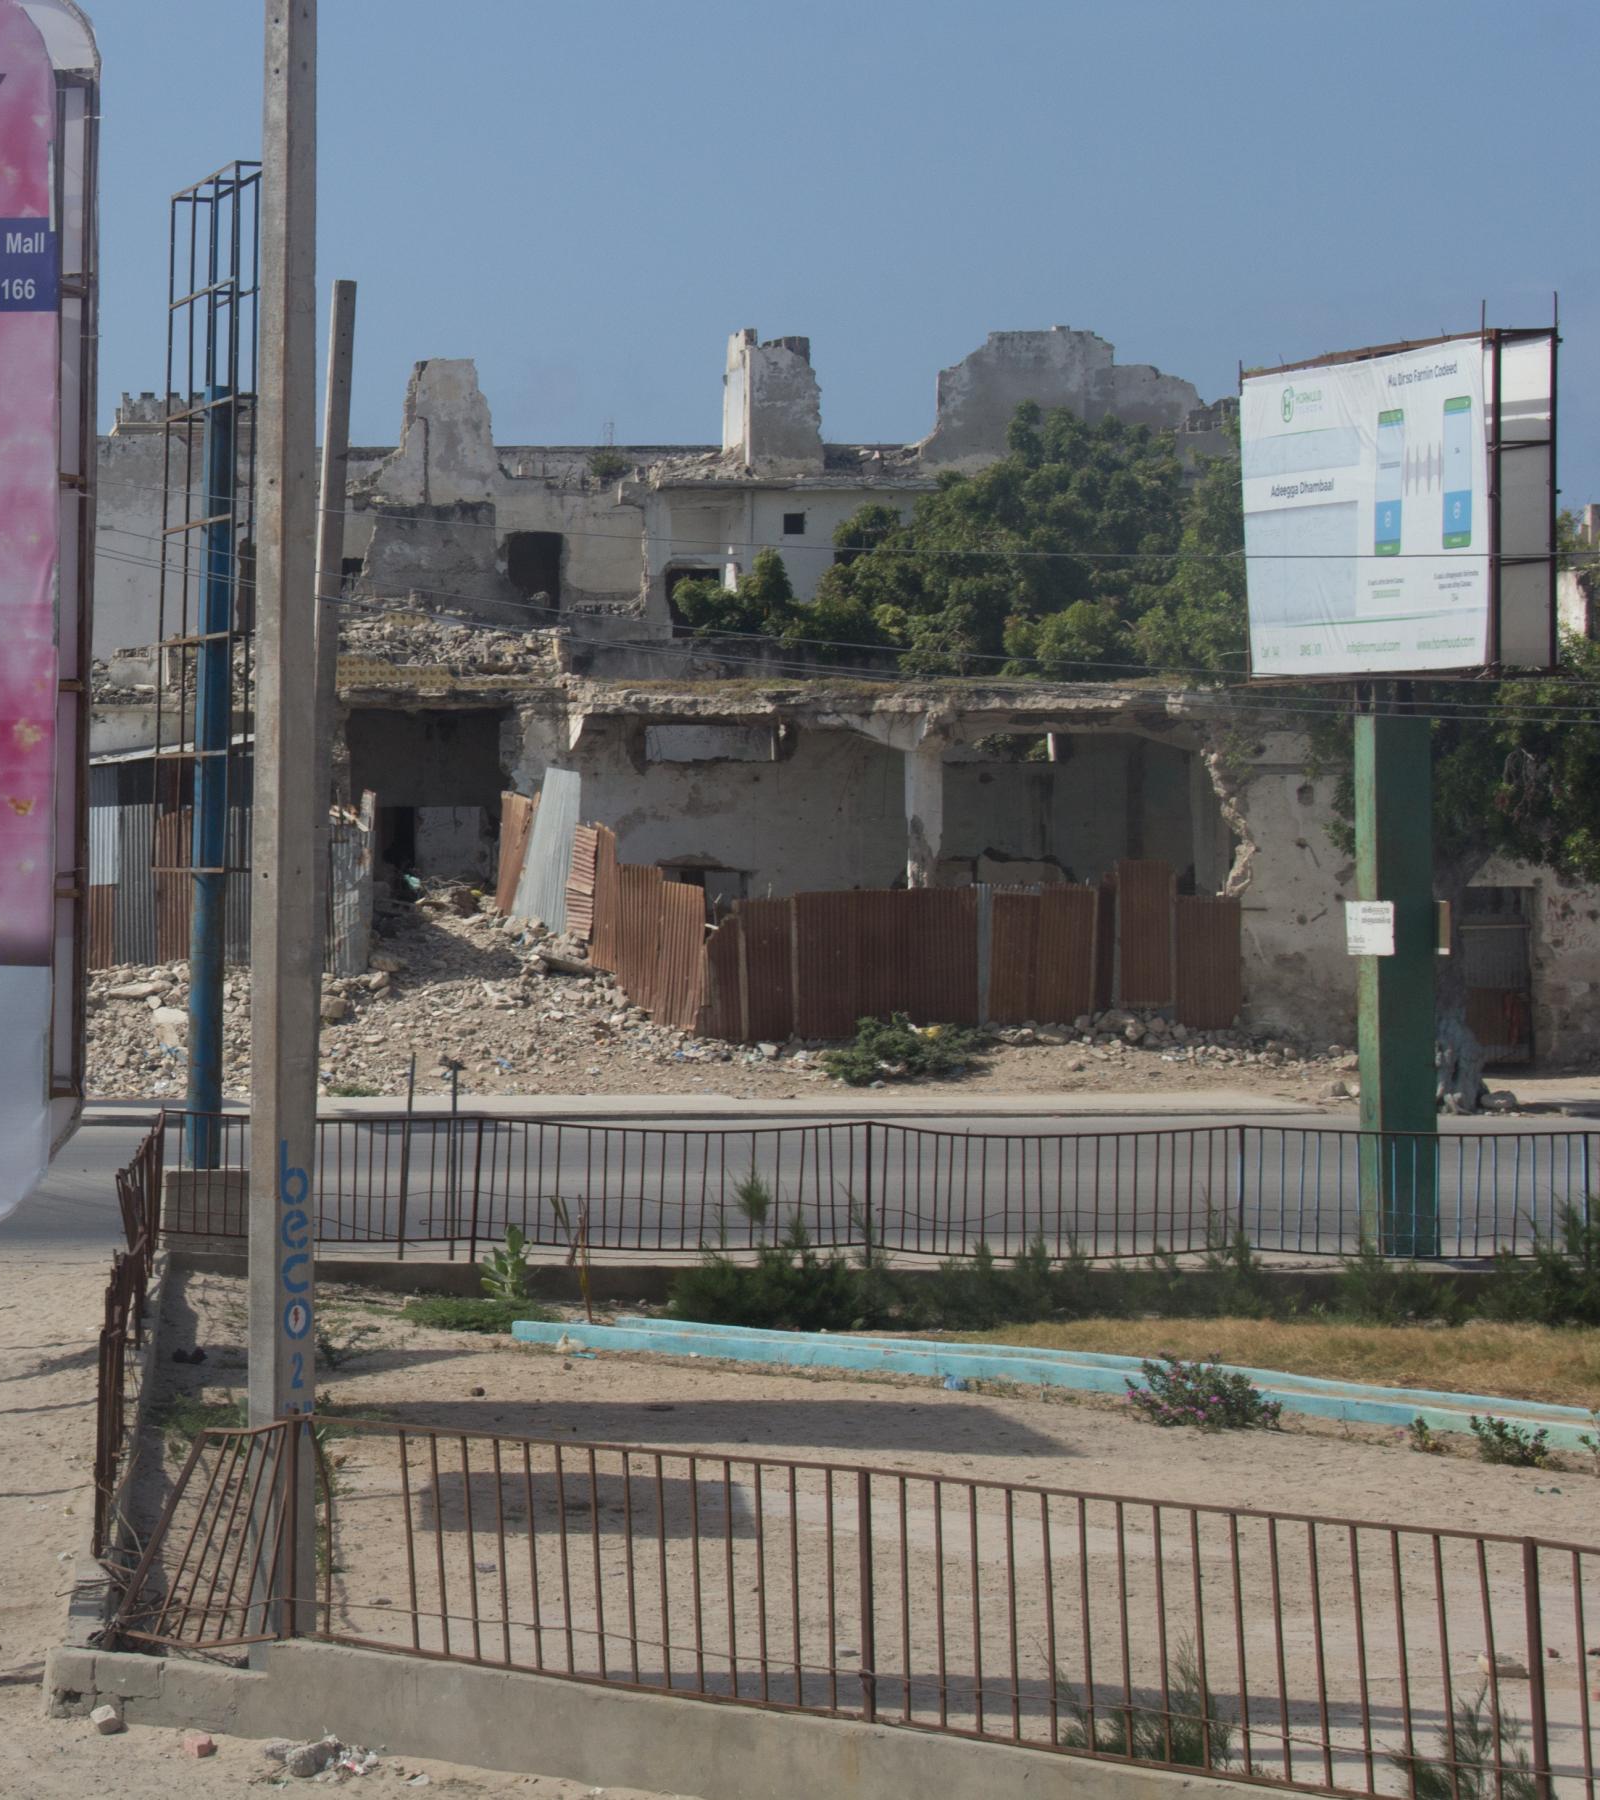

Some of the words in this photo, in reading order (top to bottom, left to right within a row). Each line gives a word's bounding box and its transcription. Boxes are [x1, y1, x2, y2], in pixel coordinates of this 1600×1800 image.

[5, 232, 45, 253] Mall
[1270, 484, 1299, 499] Adeegga
[1299, 477, 1335, 495] Dhambaal
[279, 1139, 311, 1340] beco
[289, 1352, 305, 1389] 2
